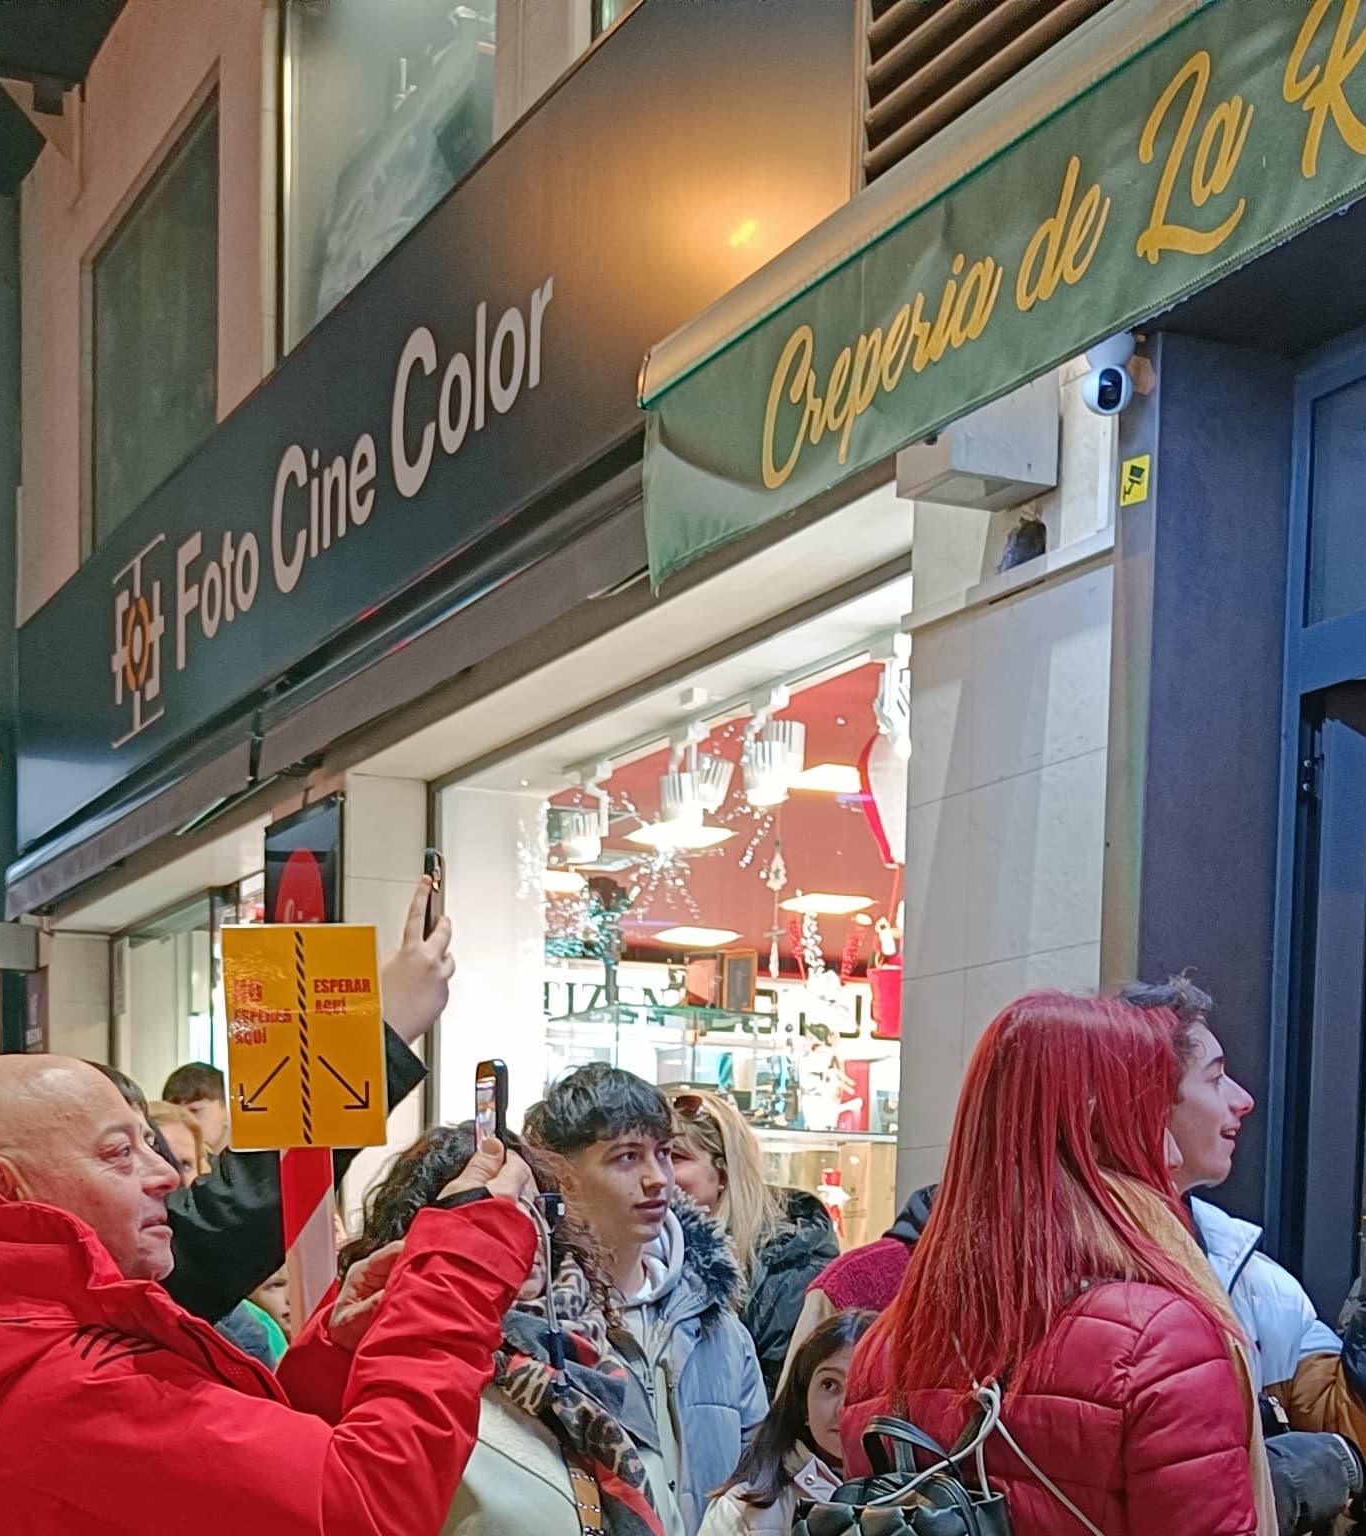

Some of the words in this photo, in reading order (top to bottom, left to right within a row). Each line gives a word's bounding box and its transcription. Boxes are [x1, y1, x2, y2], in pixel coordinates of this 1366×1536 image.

[761, 253, 1003, 490] Creperia
[1015, 156, 1111, 311] de
[1136, 50, 1254, 265] La
[176, 531, 260, 671] Foto
[271, 432, 377, 594] Cine
[390, 275, 554, 498] Color
[313, 978, 372, 994] ESPERAR
